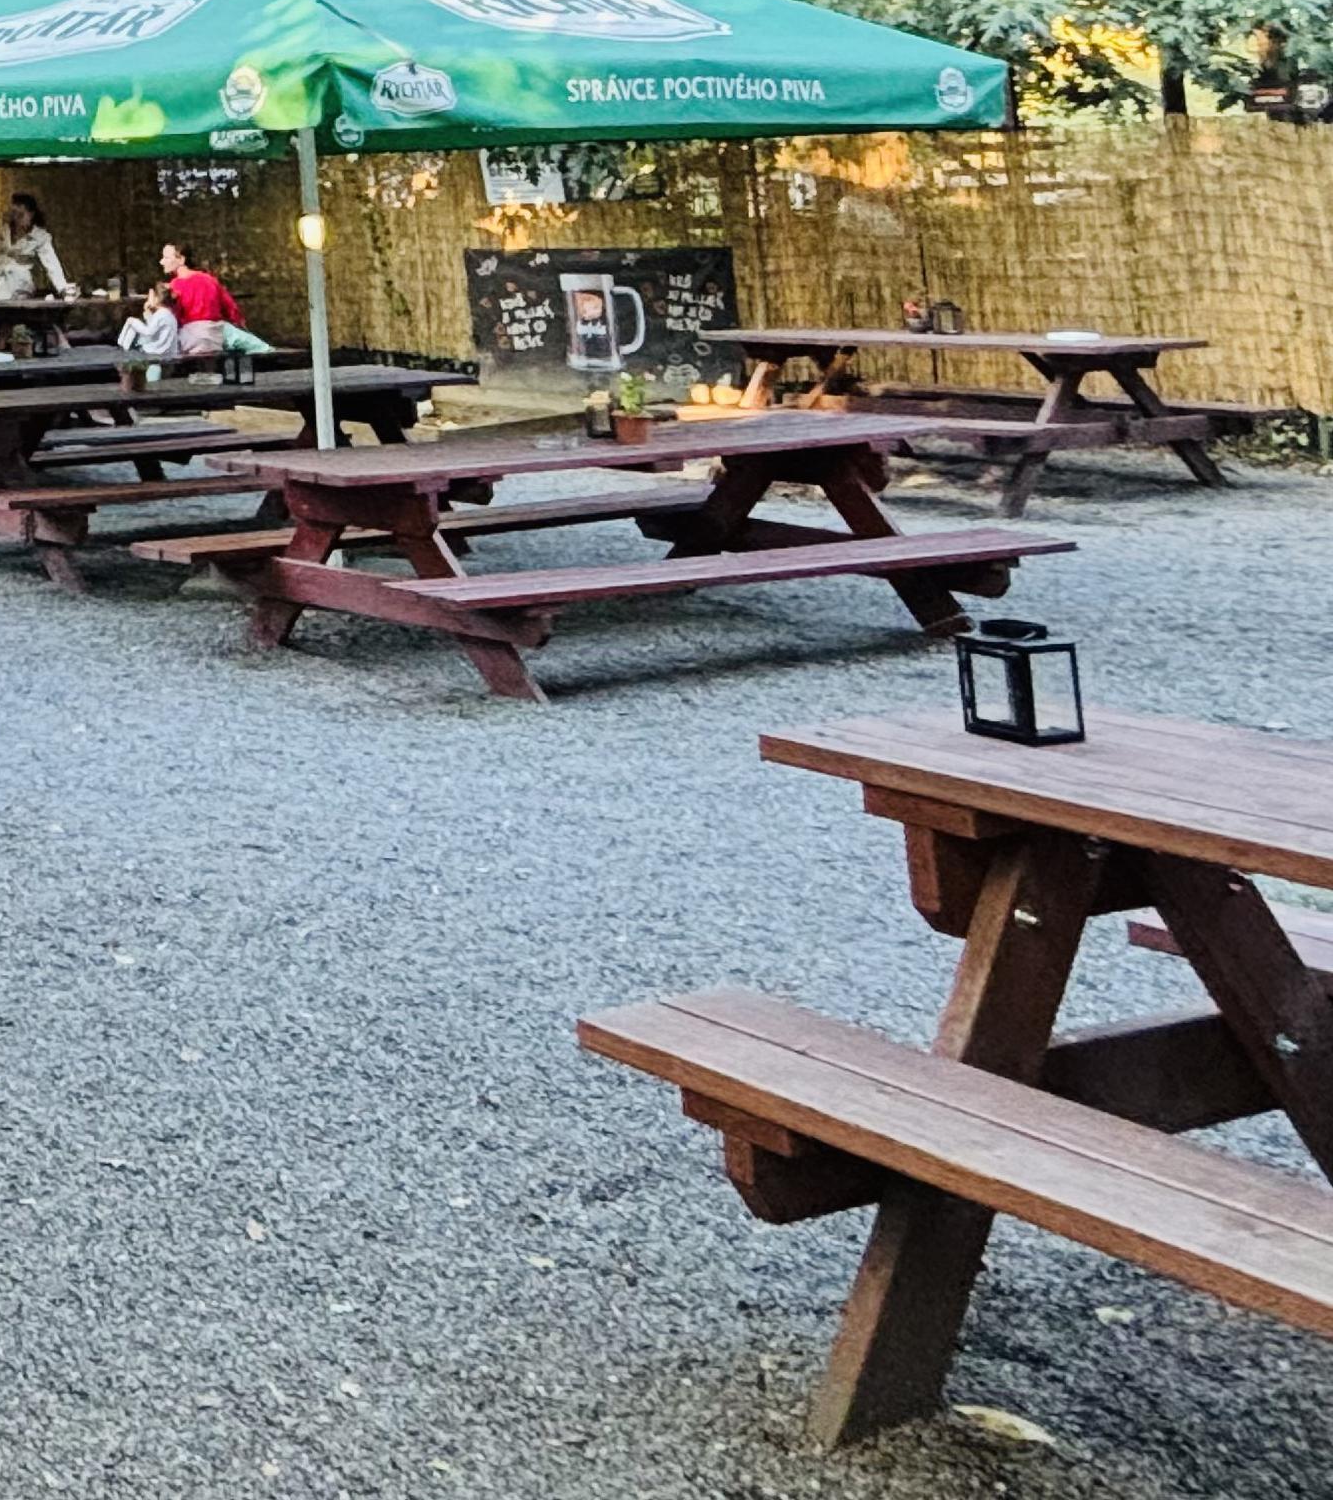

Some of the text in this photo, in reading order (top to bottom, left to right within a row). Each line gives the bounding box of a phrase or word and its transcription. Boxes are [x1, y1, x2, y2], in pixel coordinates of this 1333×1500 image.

[567, 74, 826, 103] SPRÁVCE POCTIVÉHO PIVA
[42, 94, 87, 118] PIVA
